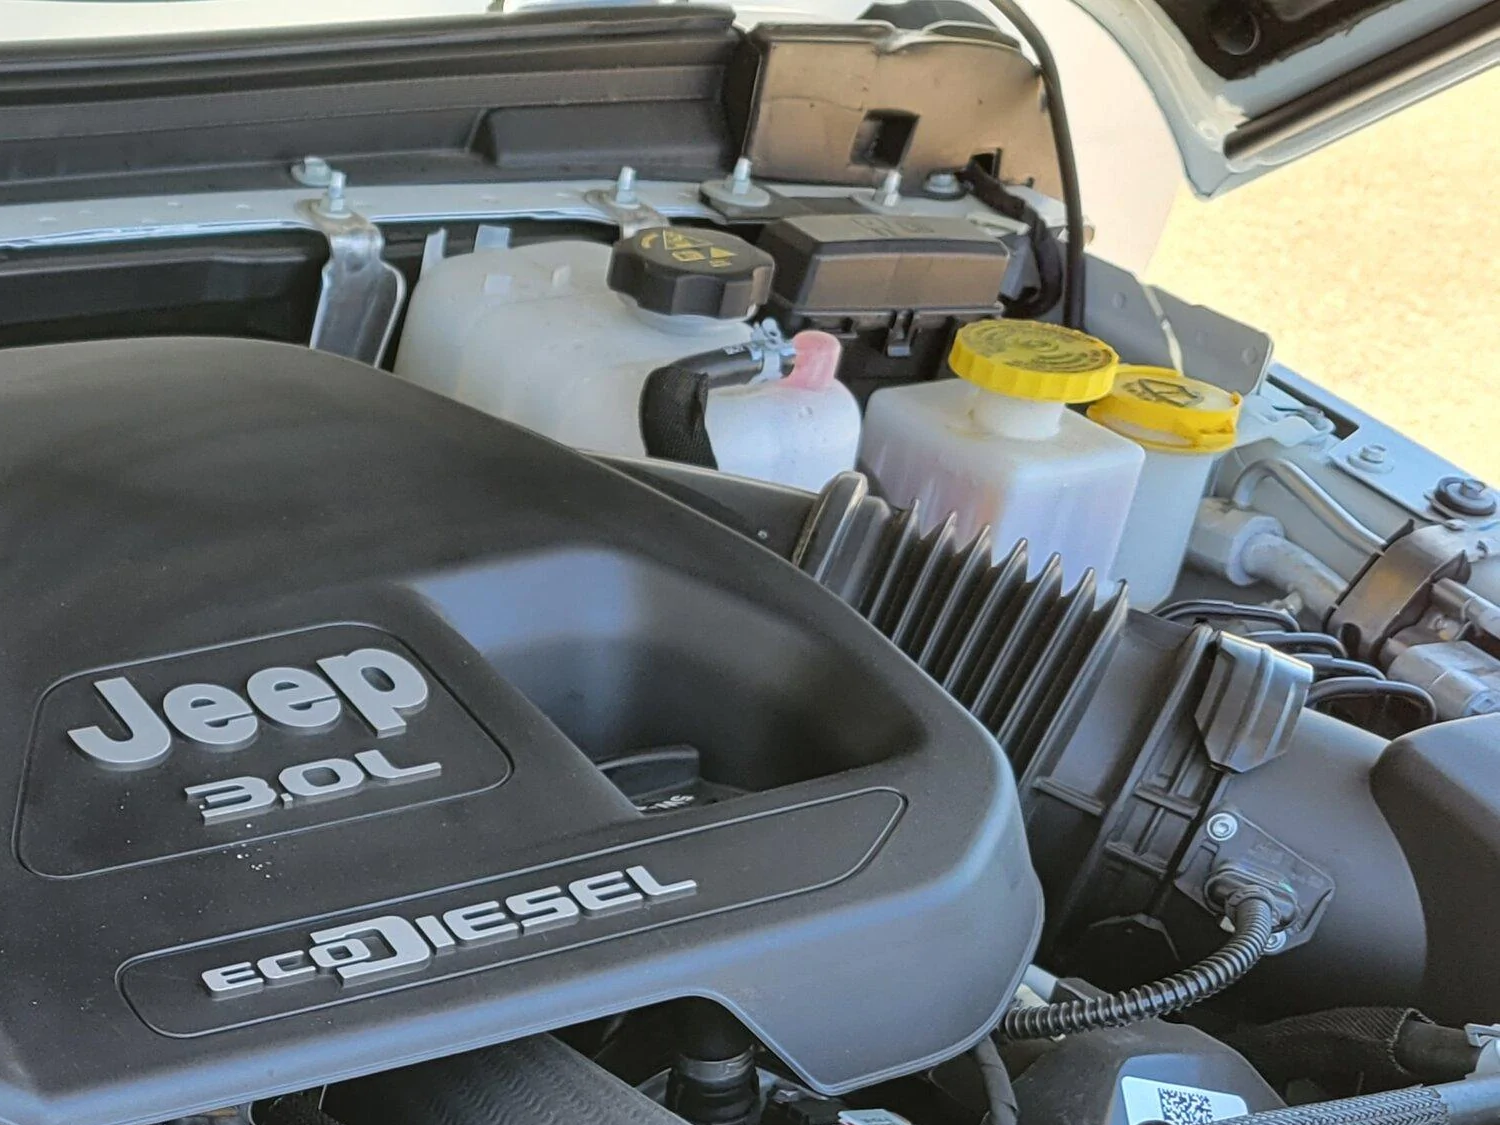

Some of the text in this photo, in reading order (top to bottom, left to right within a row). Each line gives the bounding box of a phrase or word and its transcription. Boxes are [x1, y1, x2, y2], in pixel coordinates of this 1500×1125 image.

[67, 648, 429, 771] Jeep
[184, 749, 442, 825] 3.0L
[201, 865, 697, 998] ECODIESEL
